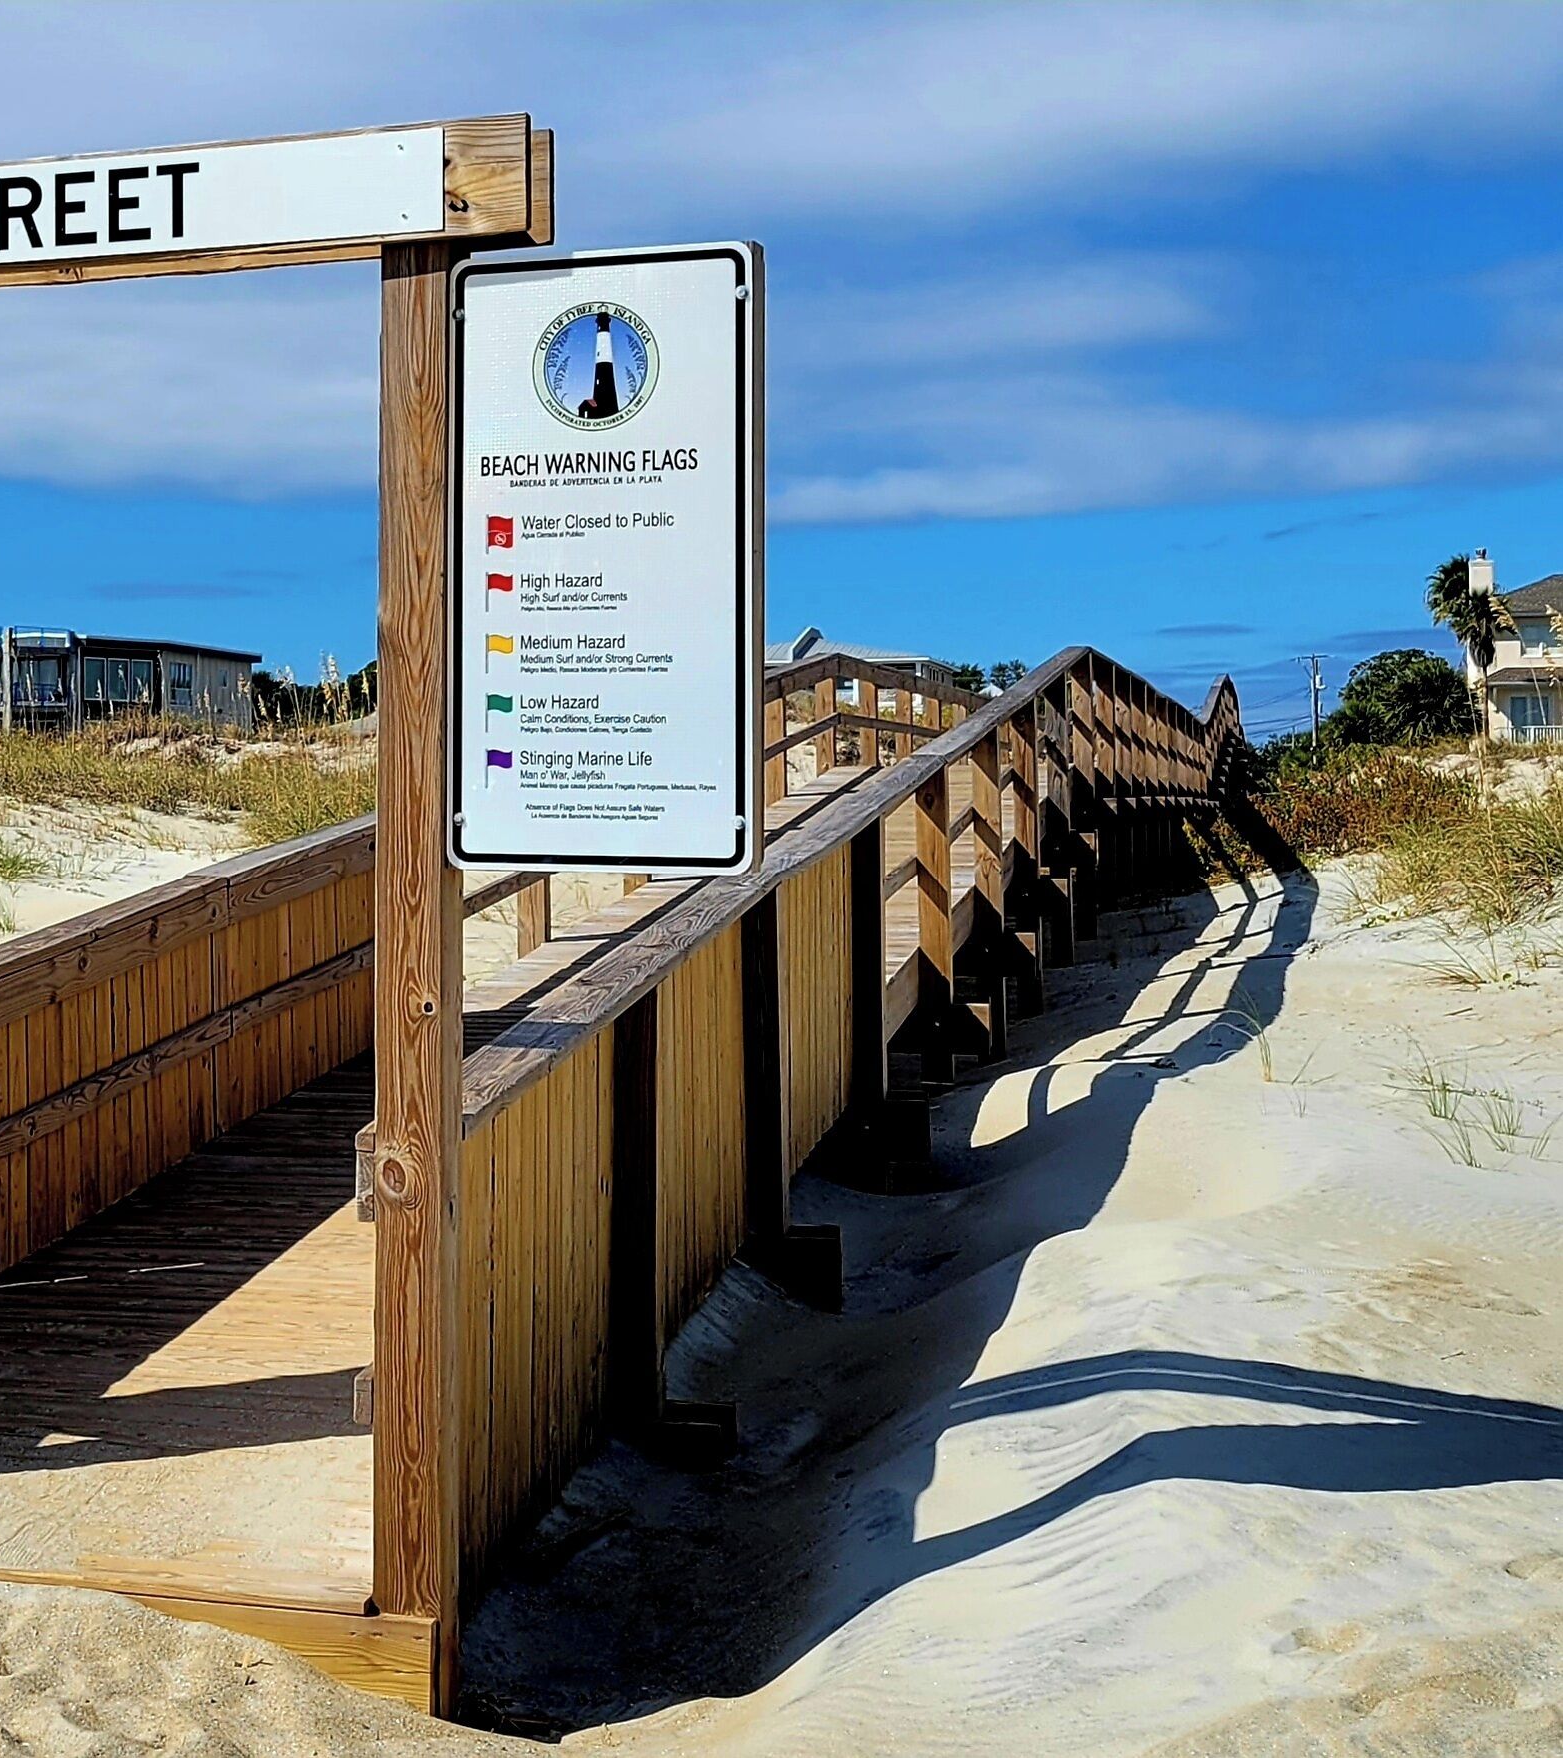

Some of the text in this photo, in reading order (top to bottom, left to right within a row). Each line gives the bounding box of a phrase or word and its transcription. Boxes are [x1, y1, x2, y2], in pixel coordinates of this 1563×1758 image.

[539, 305, 652, 351] CITY OF TYBEE ISLAND GA
[481, 448, 697, 476] BEACH WARNING FLAGS
[510, 479, 546, 487] BANDERAS
[550, 478, 559, 486] DE
[562, 477, 610, 486] ADVERTENCIA
[627, 476, 635, 484] LA
[522, 512, 674, 530] Water Closed to Public
[521, 573, 602, 592] High Hazard
[521, 592, 627, 605] High Surf and/or Currents
[521, 634, 625, 649] Medium Hazard
[520, 653, 673, 665] Medium Surf and/or Strong Currents
[520, 694, 599, 709] Low Hazard
[520, 714, 666, 725] Calm Conditions, Exercise Caution
[520, 750, 652, 769] Stinging Marine Life
[520, 770, 538, 779] Man
[550, 770, 569, 781] War,
[571, 770, 605, 782] Jellyfish
